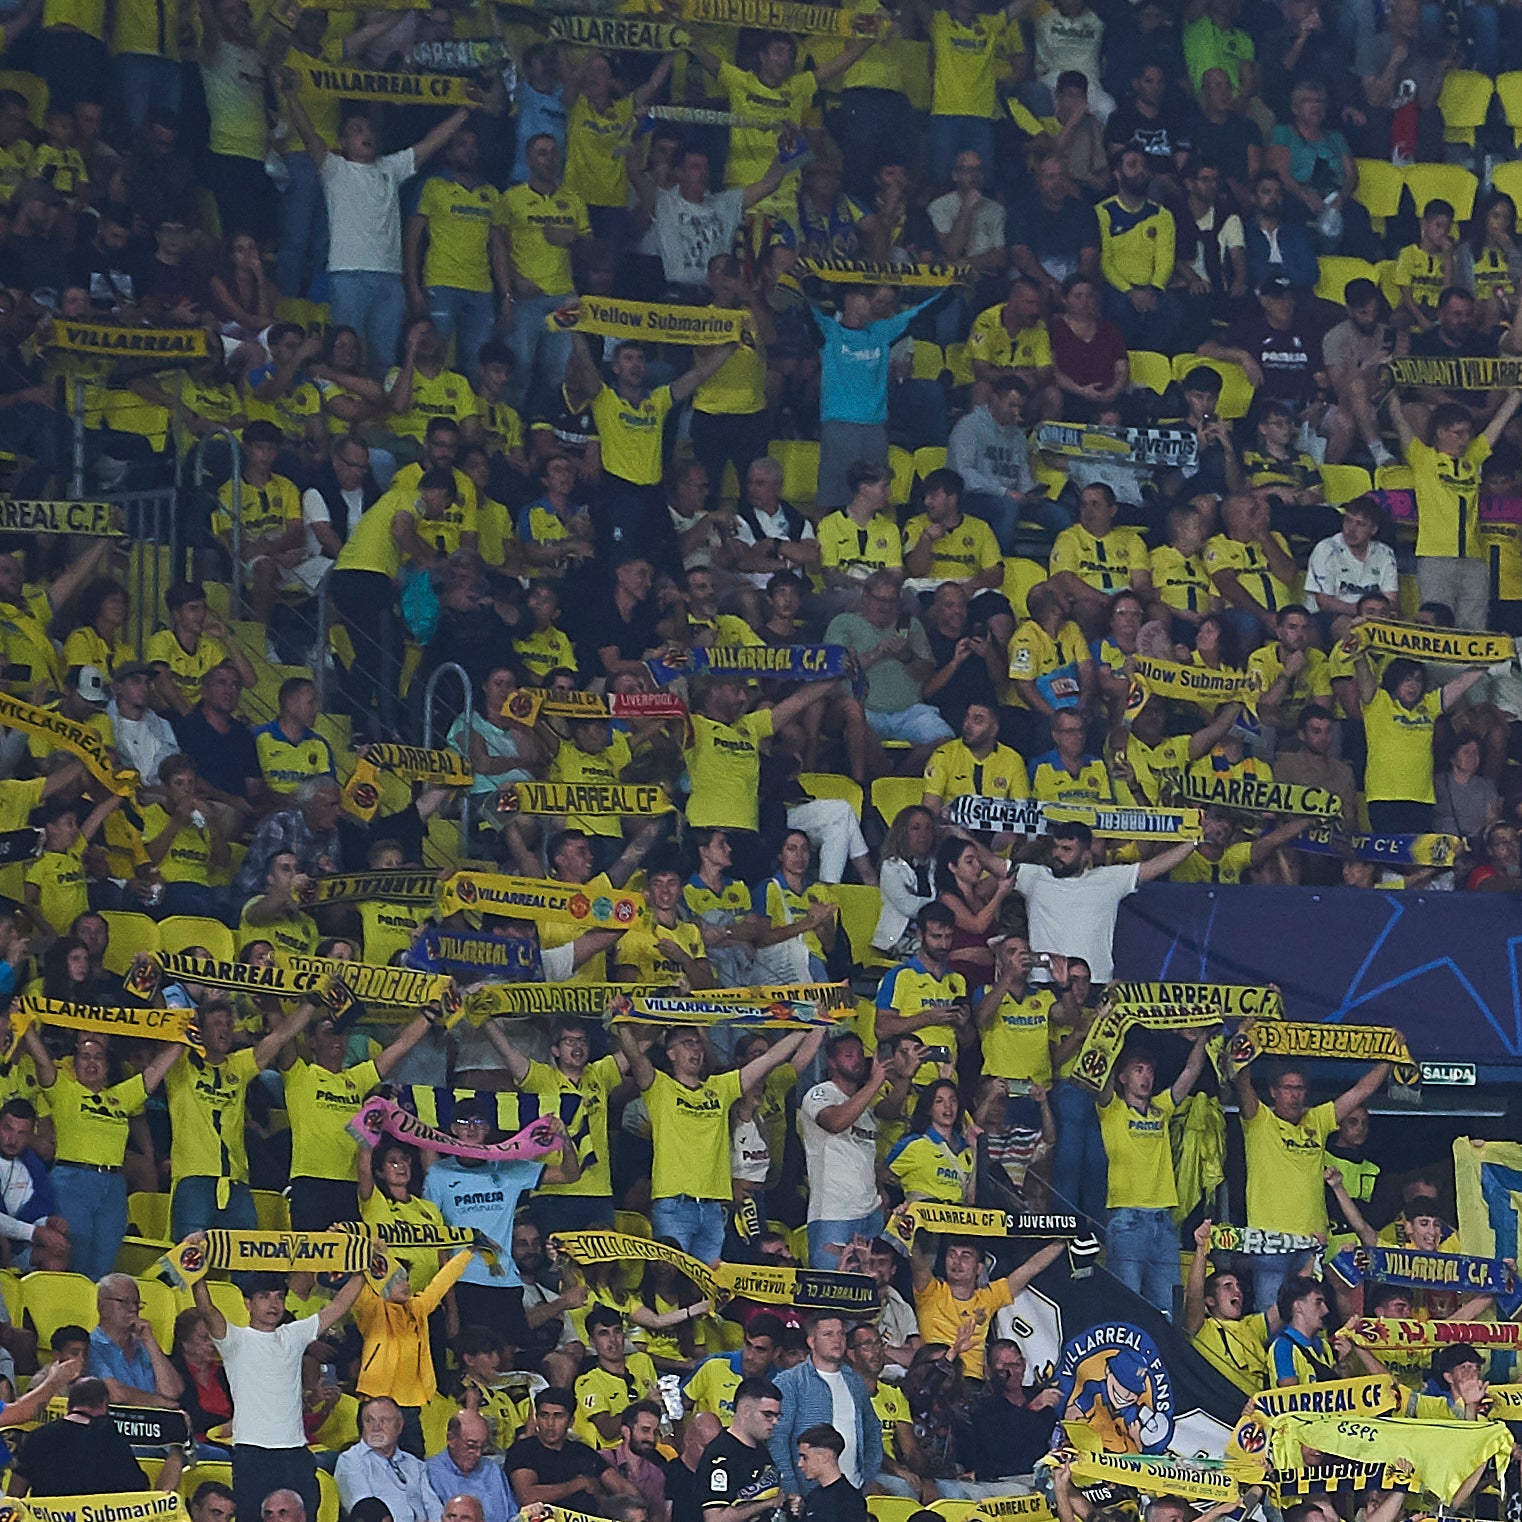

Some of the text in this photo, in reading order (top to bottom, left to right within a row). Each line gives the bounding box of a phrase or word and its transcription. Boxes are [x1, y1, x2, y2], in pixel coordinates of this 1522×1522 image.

[312, 70, 422, 96] VILLARREAL
[590, 303, 733, 332] Yellow Submarine
[1366, 627, 1462, 656] VILLARREAL
[706, 644, 791, 669] VILLARREAL
[529, 785, 658, 813] VILLARREAL CF
[160, 952, 320, 991] VILLARREAL CF
[1423, 1066, 1474, 1082] SALIDA
[919, 1209, 1077, 1229] VILLARREAL CF VS JUVENTUS
[240, 1236, 338, 1265] ENDAVANT
[1059, 1322, 1171, 1415] VILLARREAL FANS
